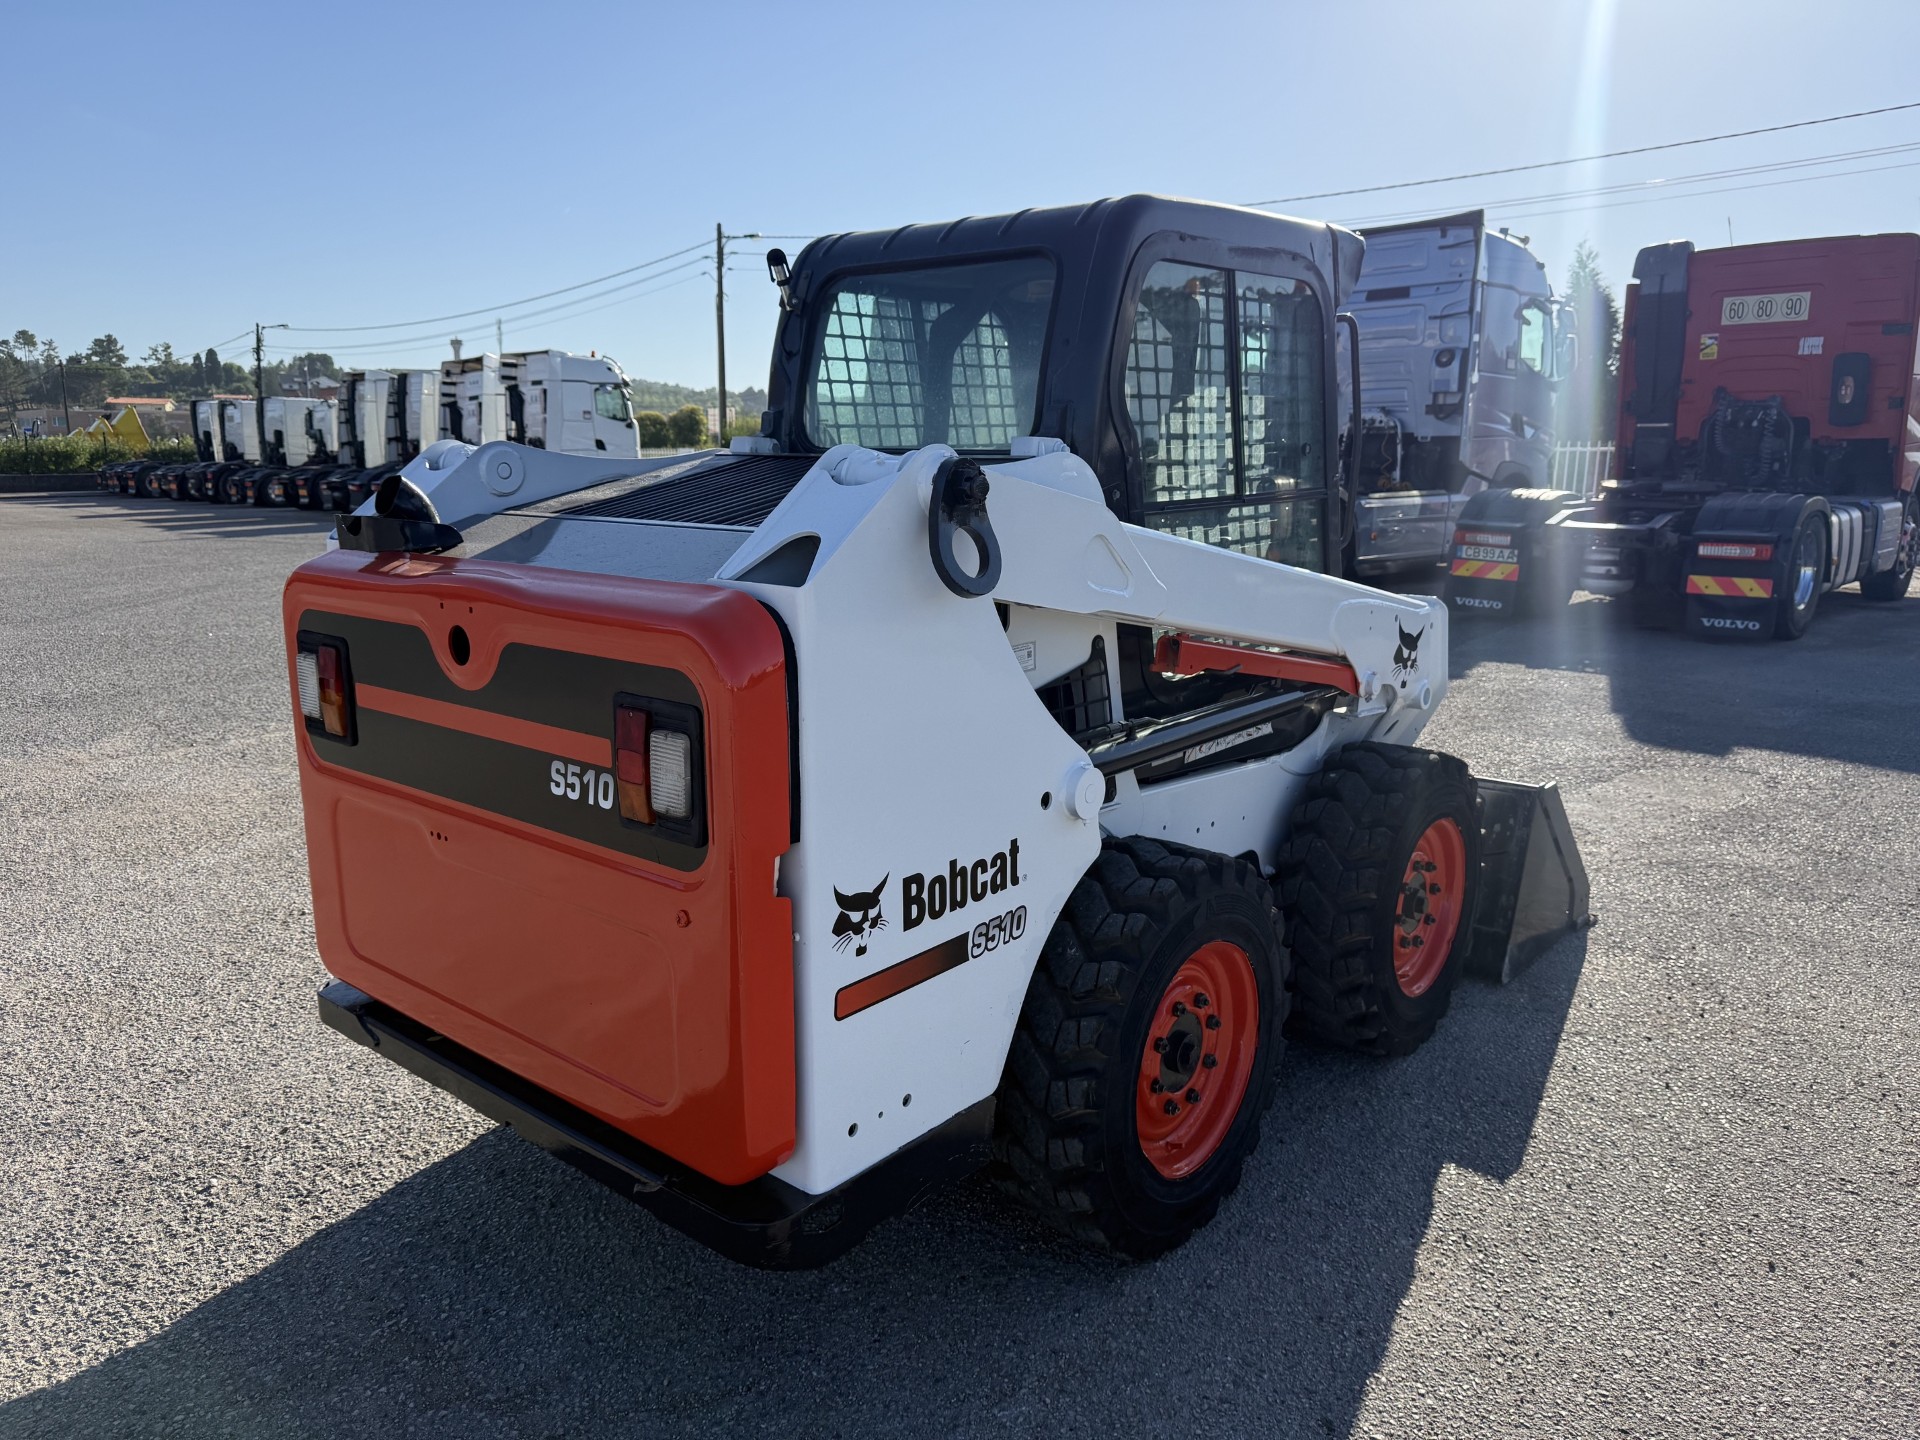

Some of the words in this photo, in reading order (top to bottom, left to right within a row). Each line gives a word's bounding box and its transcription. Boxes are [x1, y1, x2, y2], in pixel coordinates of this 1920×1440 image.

[1728, 301, 1745, 320] 60
[1756, 299, 1773, 318] 80
[1786, 297, 1802, 316] 90
[1454, 596, 1503, 610] VOLVO
[1700, 617, 1760, 631] VOLVO
[550, 760, 614, 810] S510
[902, 837, 1020, 932] Bobcat
[970, 904, 1027, 959] S510
